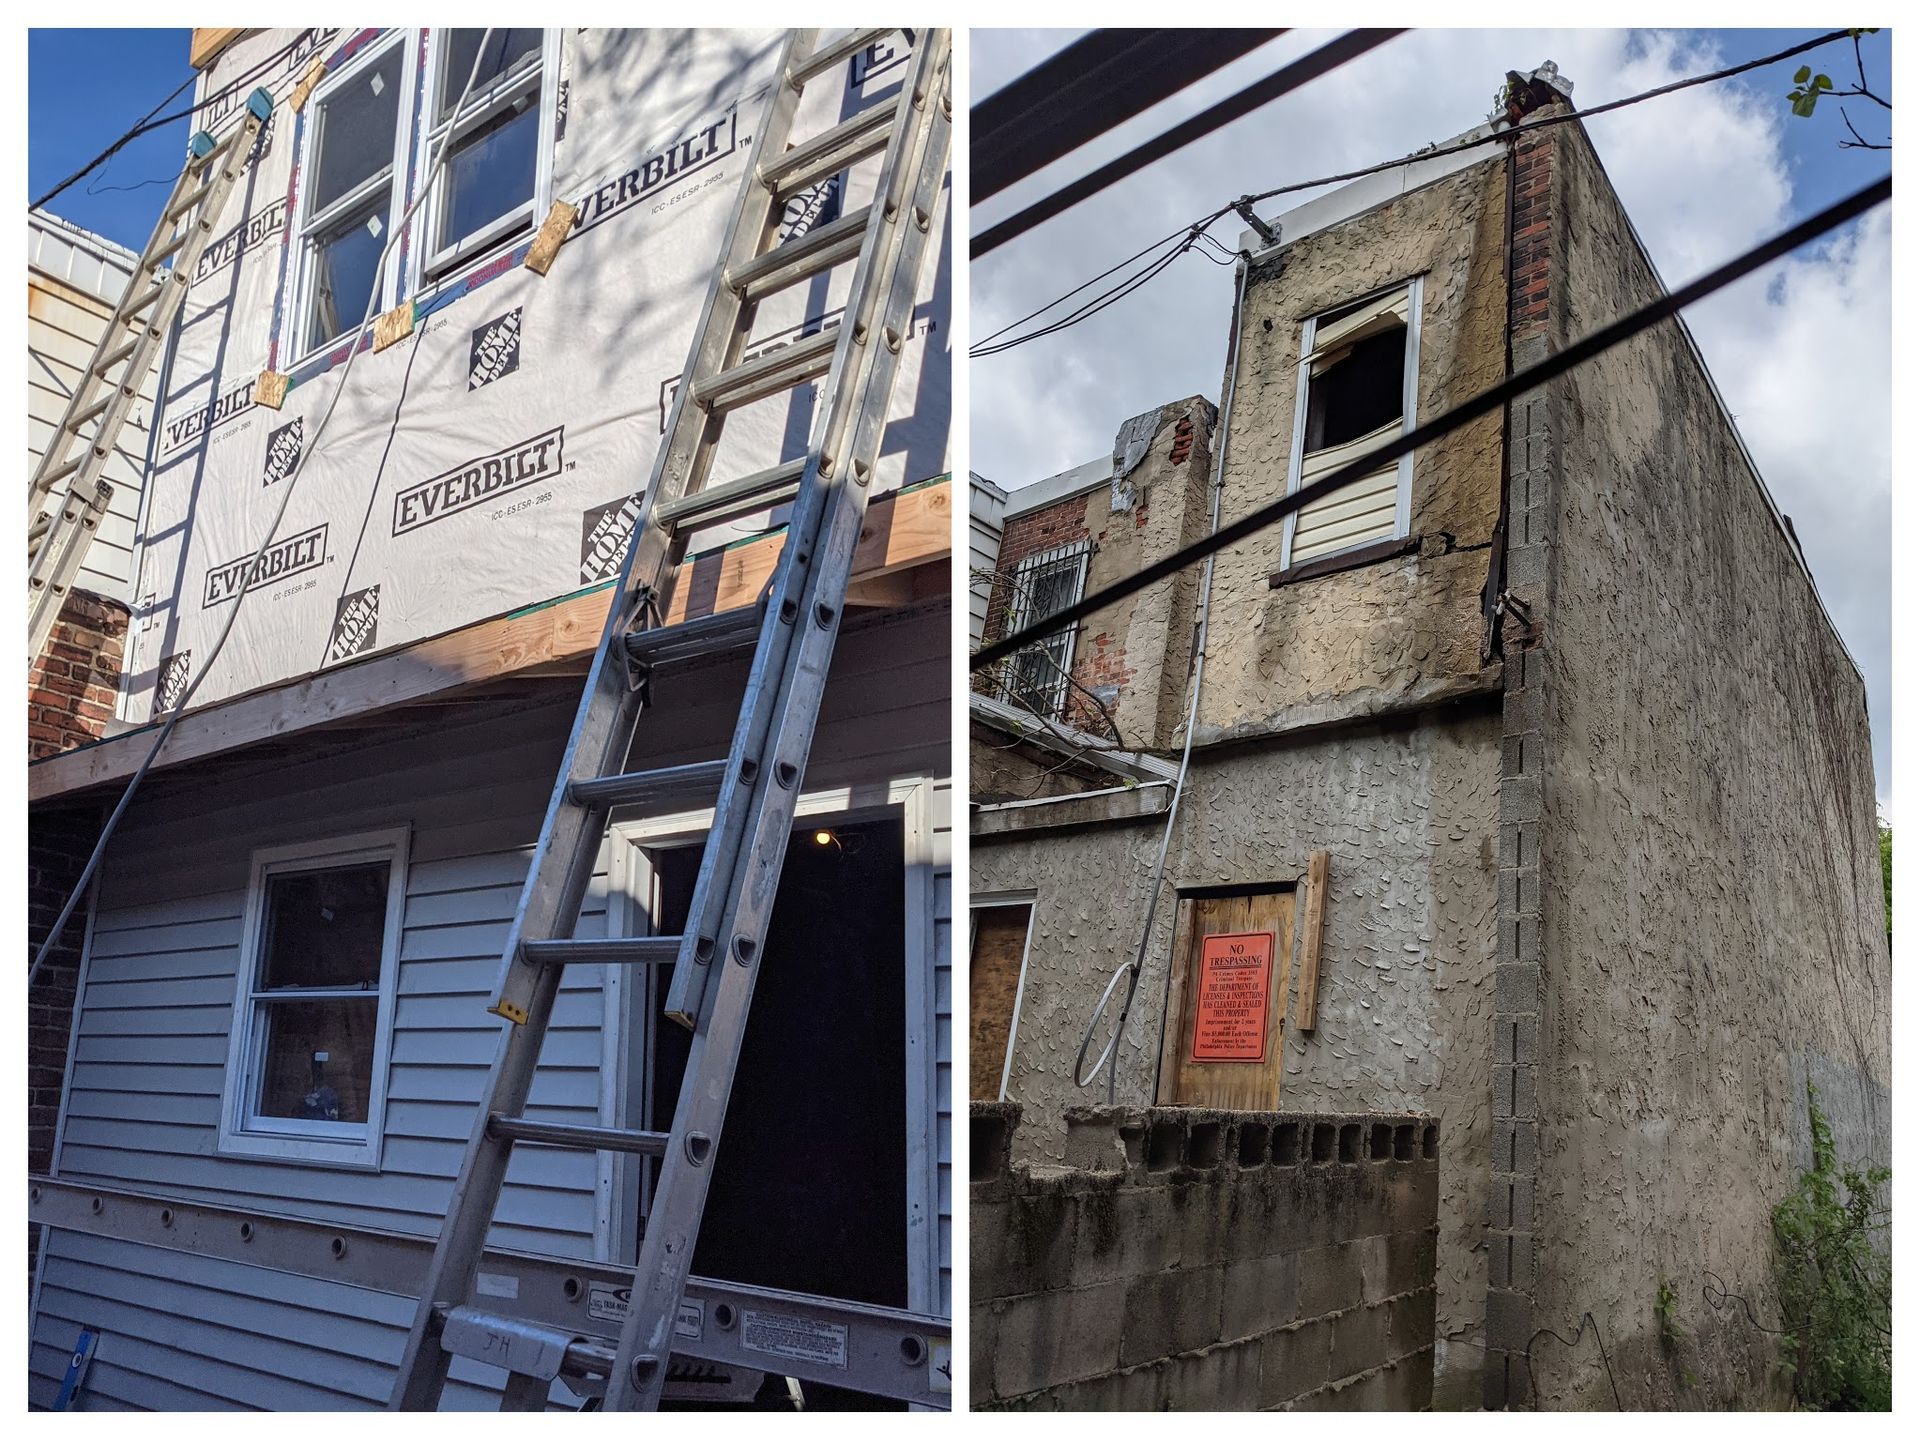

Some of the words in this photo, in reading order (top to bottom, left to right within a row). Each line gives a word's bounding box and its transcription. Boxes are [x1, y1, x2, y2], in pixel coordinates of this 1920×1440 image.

[738, 136, 753, 150] TM
[475, 326, 497, 356] THE
[919, 321, 937, 336] TM
[469, 309, 521, 389] HOME
[489, 330, 520, 381] DEPOT
[263, 418, 304, 485] HOME
[268, 431, 286, 457] THE
[277, 437, 303, 479] DEPOT
[399, 437, 555, 528] EVERBILT
[565, 460, 576, 472] TM
[580, 493, 642, 582] HOME
[587, 509, 615, 544] THE
[207, 532, 322, 601] EVERBILT
[333, 586, 380, 659] HOME
[339, 598, 358, 627] THE
[349, 608, 379, 655] DEPOT
[155, 651, 190, 711] HOME
[1209, 955, 1263, 967] TRESPASSING
[1229, 944, 1245, 955] NO
[1203, 992, 1226, 1000] LICENSES
[1231, 991, 1264, 999] INSPECTIONS
[1219, 983, 1251, 991] DEPARTMENT
[1252, 982, 1259, 990] OF
[1202, 1001, 1213, 1009] HAS
[1213, 1000, 1237, 1008] CLEANED
[1242, 1000, 1262, 1008] SEALED
[1213, 1009, 1224, 1017] THIS
[1225, 1009, 1250, 1017] PROPERTY
